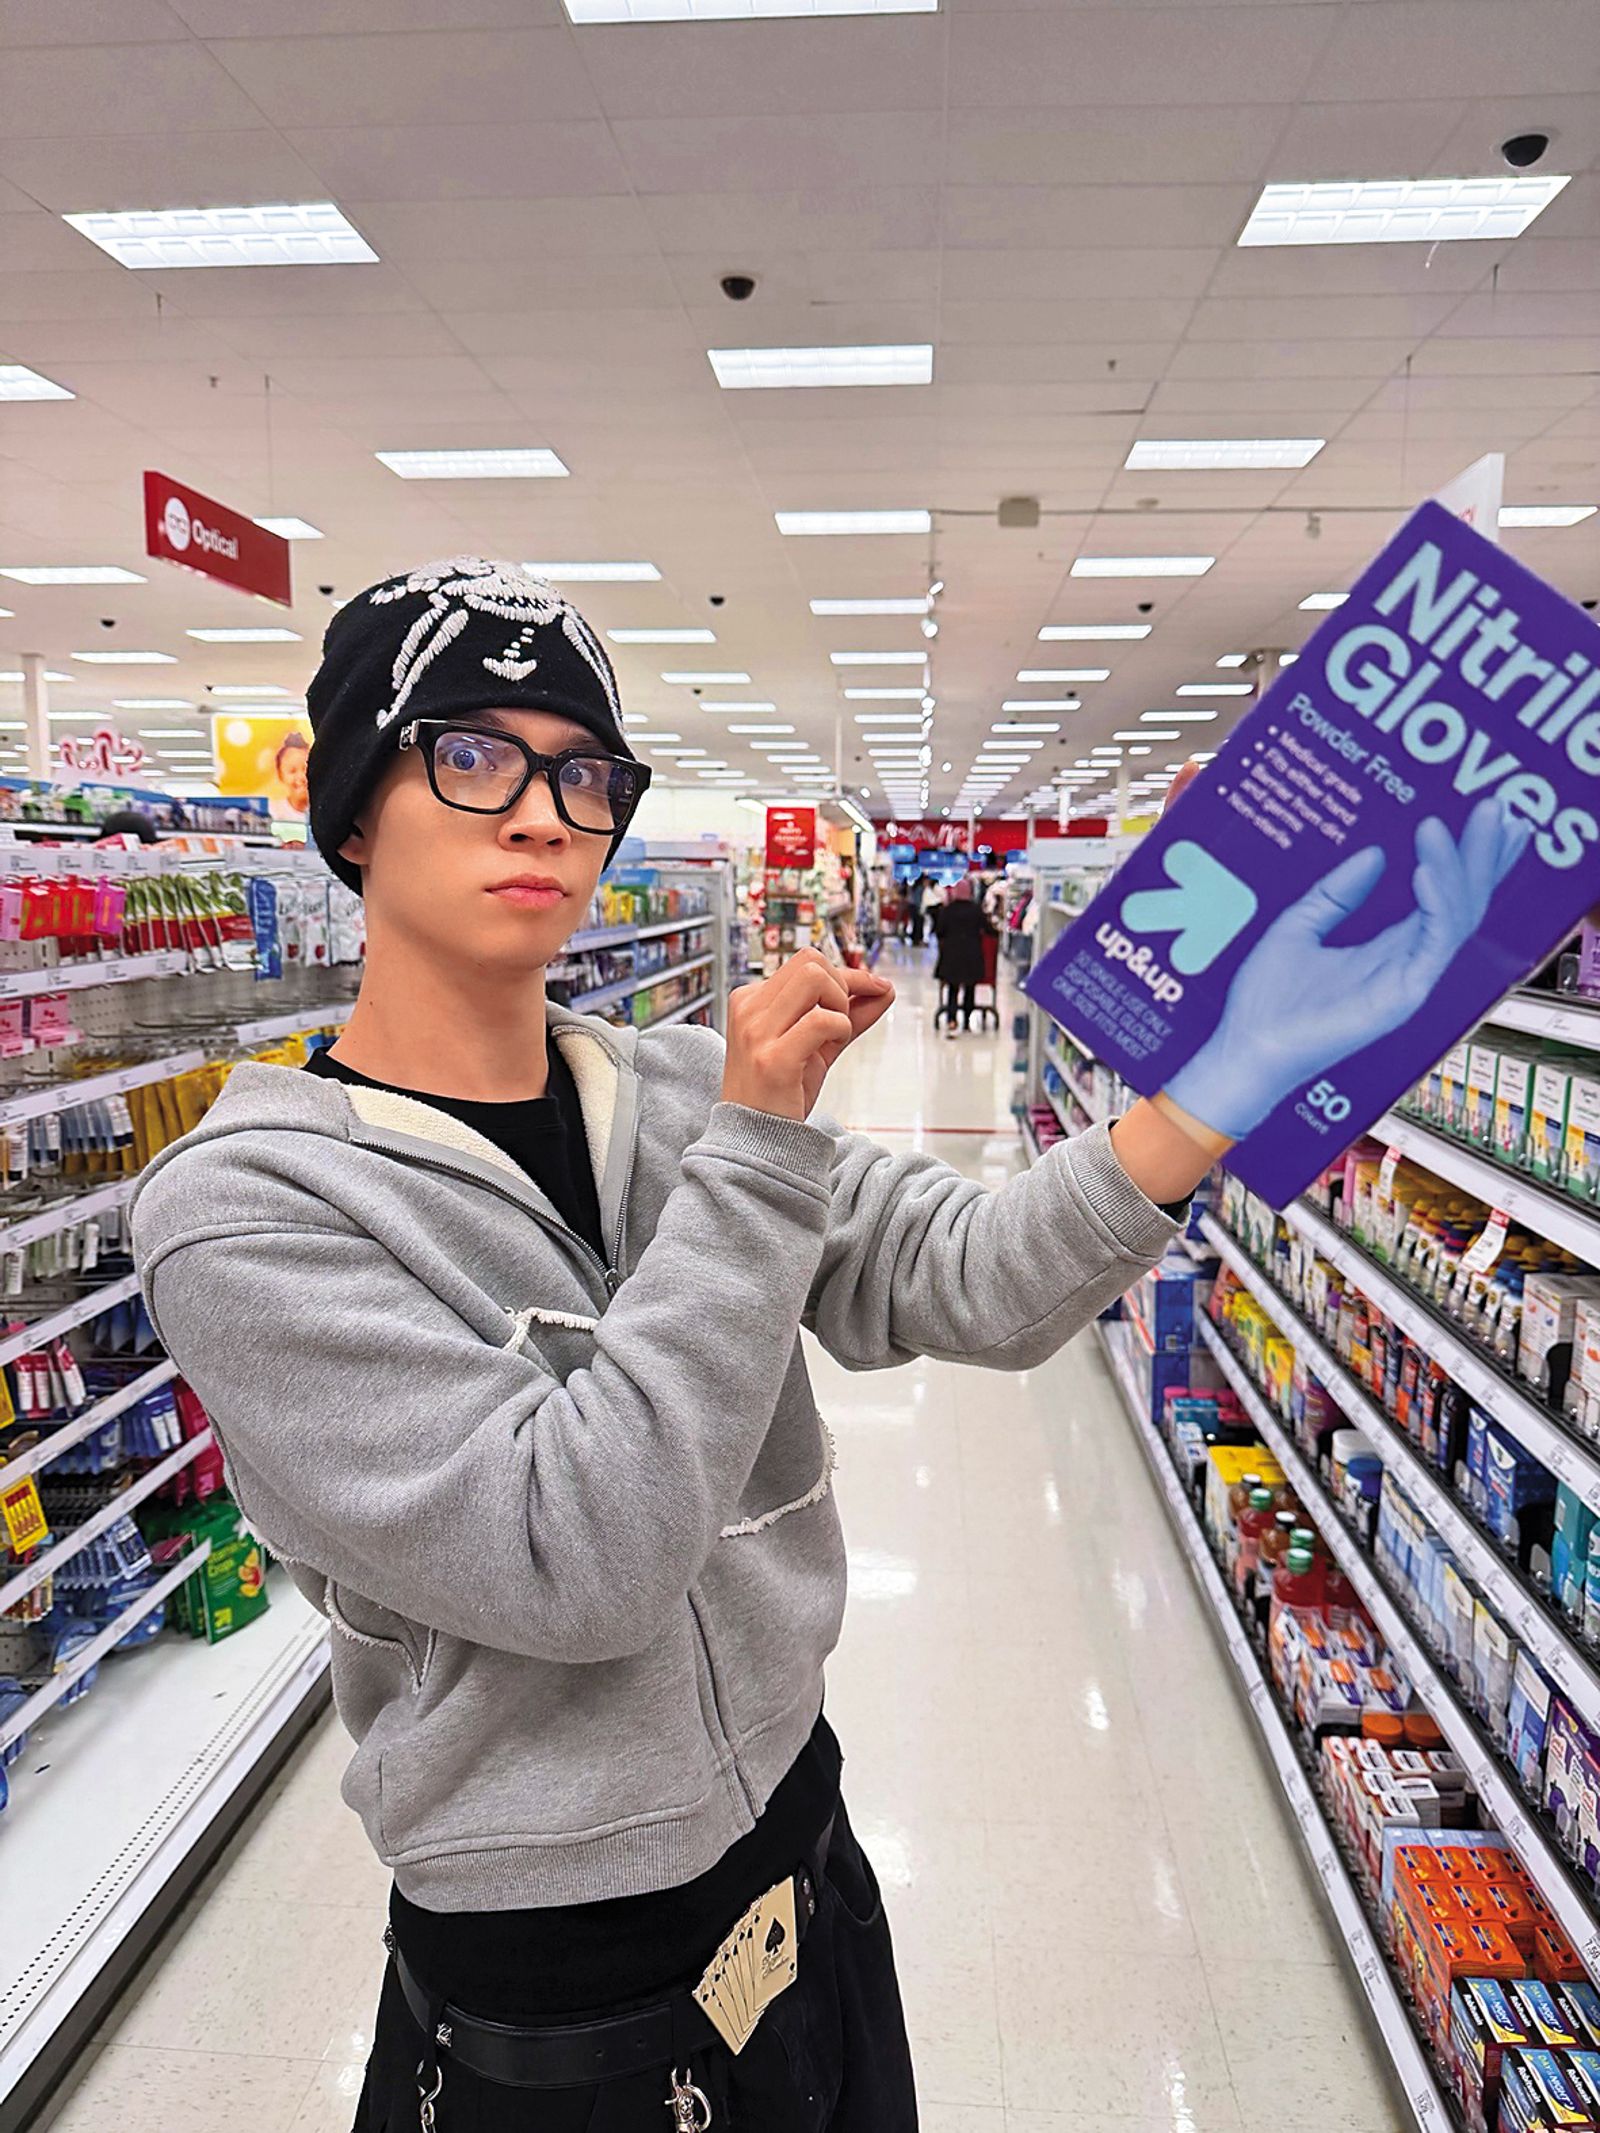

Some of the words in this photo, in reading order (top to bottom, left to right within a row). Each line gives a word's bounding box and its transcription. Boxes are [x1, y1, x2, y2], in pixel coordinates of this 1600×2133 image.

[192, 518, 239, 560] Optical
[1279, 731, 1329, 776] Medical
[1322, 770, 1363, 805] grade
[1287, 692, 1370, 764] Powder
[1364, 754, 1416, 805] Free
[1325, 624, 1599, 869] Gloves
[1240, 778, 1269, 802] and
[1262, 796, 1305, 833] germs
[1251, 763, 1295, 801] Barrier
[1290, 796, 1324, 827] from
[1319, 820, 1347, 846] dirt
[1264, 747, 1290, 774] Fits
[1286, 767, 1325, 800] either
[1320, 793, 1358, 827] hand
[1227, 791, 1293, 849] Non-sterile
[1095, 922, 1185, 1003] up&up
[1052, 974, 1079, 1000] ONE
[1073, 992, 1098, 1020] SIZE
[1091, 1010, 1119, 1037] FITS
[1113, 1028, 1149, 1061] MOST
[1062, 961, 1126, 1021] DISPOSABLE
[1119, 1011, 1163, 1052] GLOVES
[1141, 1008, 1173, 1039] ONLY
[1294, 1102, 1330, 1135] Count
[1306, 1080, 1352, 1121] 50
[1463, 1993, 1485, 2026] Robitussin
[1493, 2000, 1513, 2027] NIGHT
[1510, 1995, 1533, 2028] Robitussin
[1539, 2001, 1562, 2029] NIGHT
[1557, 1996, 1581, 2030] Robitussin
[1517, 2066, 1542, 2103] Robitussin
[1537, 2054, 1550, 2070] DAY
[1549, 2073, 1573, 2106] NIGHT
[1566, 2068, 1592, 2105] Robitussin
